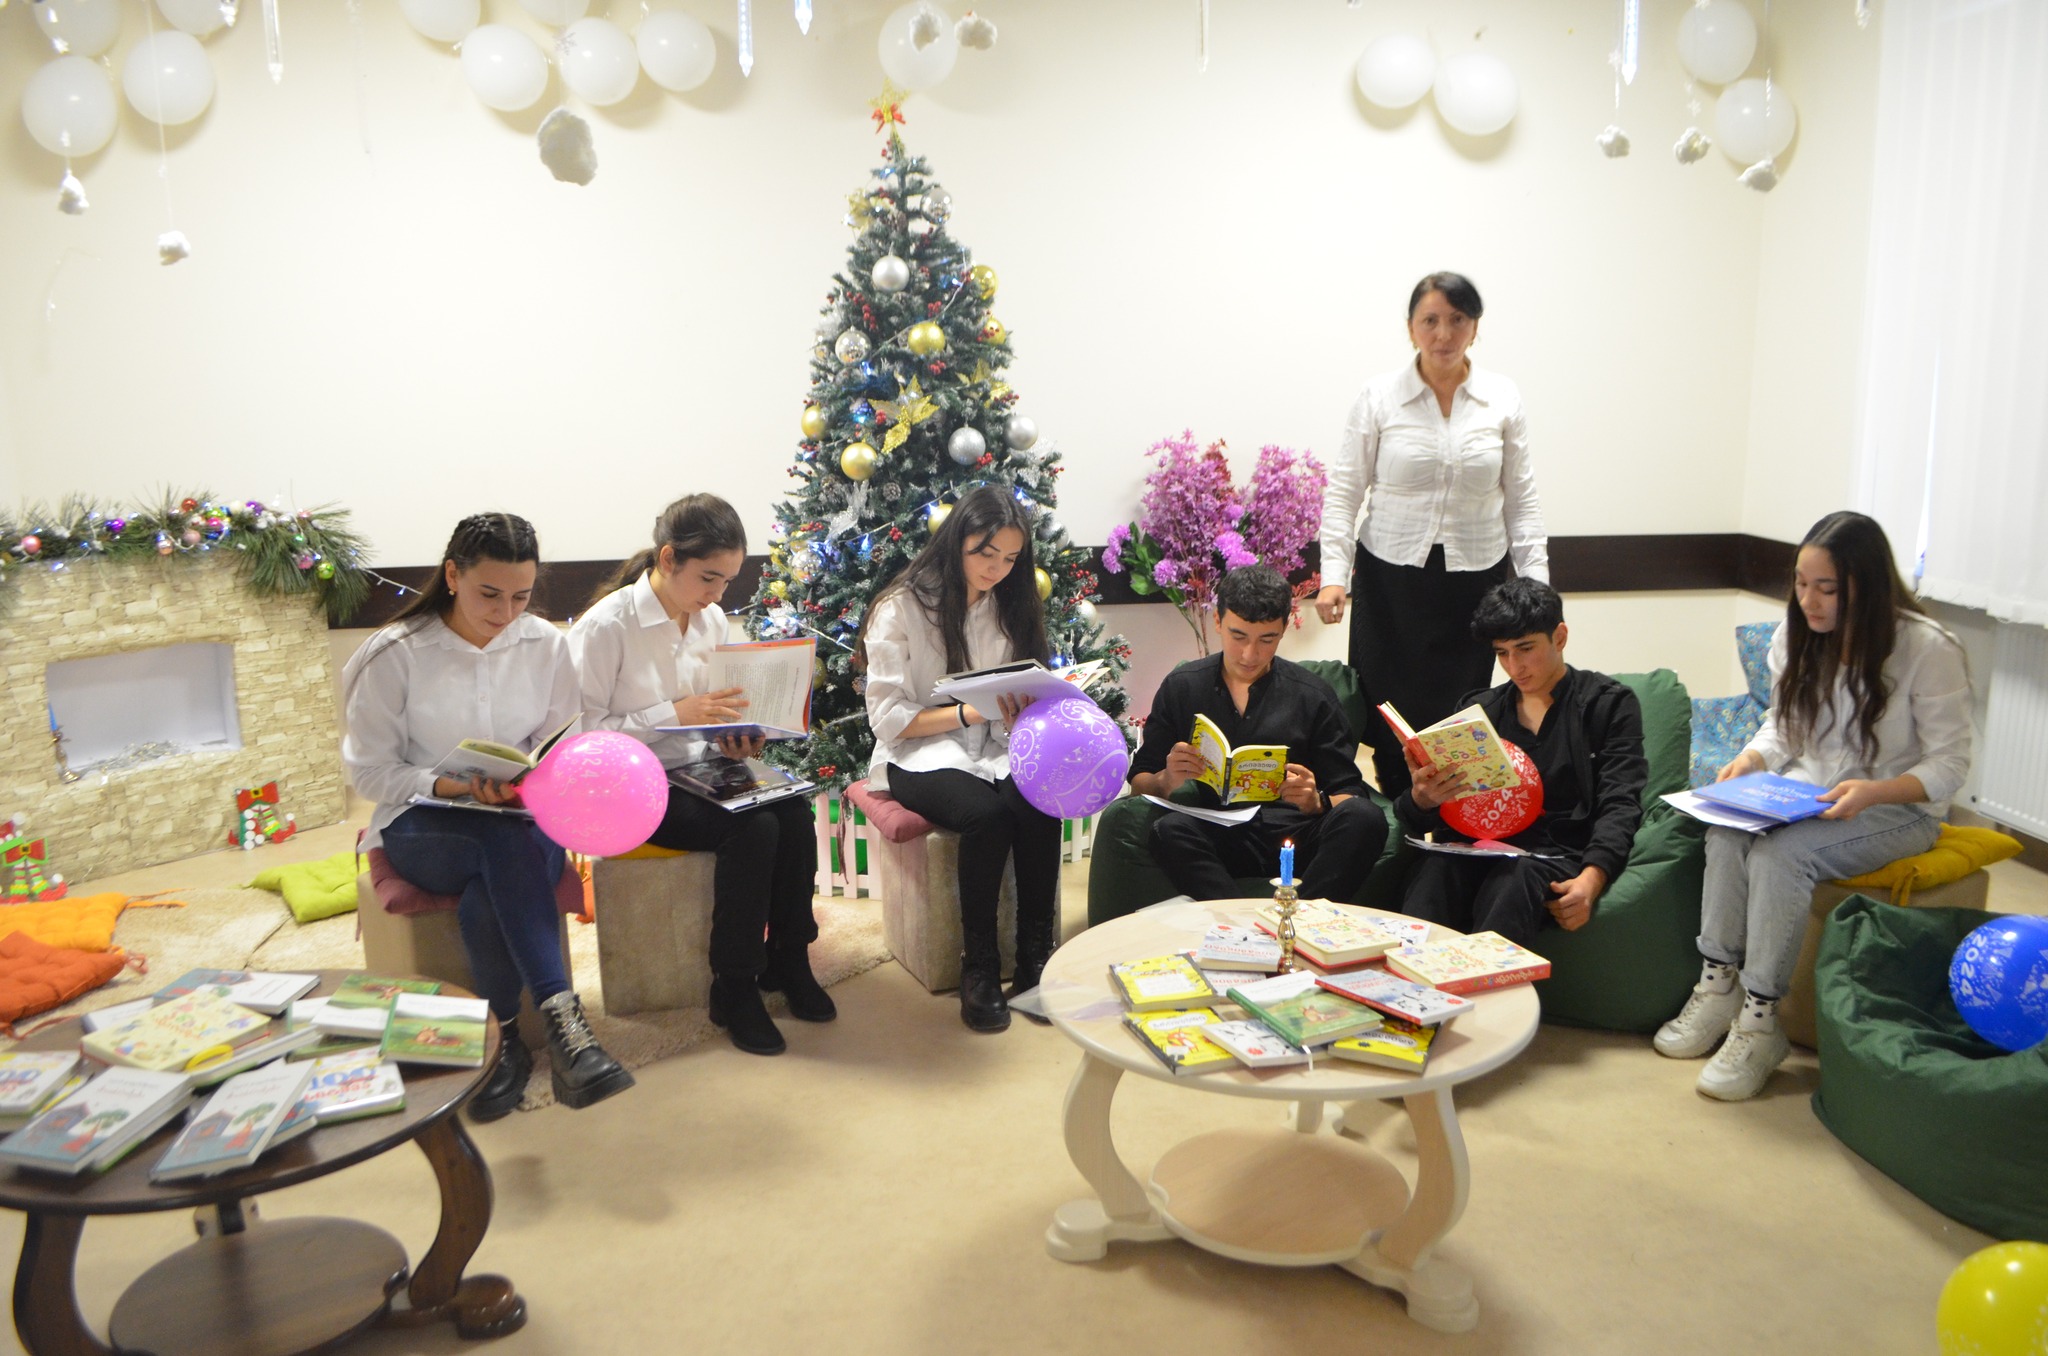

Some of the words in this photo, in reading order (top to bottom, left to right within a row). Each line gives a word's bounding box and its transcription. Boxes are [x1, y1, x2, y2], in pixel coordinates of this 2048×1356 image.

[1076, 775, 1106, 818] 202
[1480, 788, 1513, 829] 2024
[1960, 933, 1987, 997] 2024
